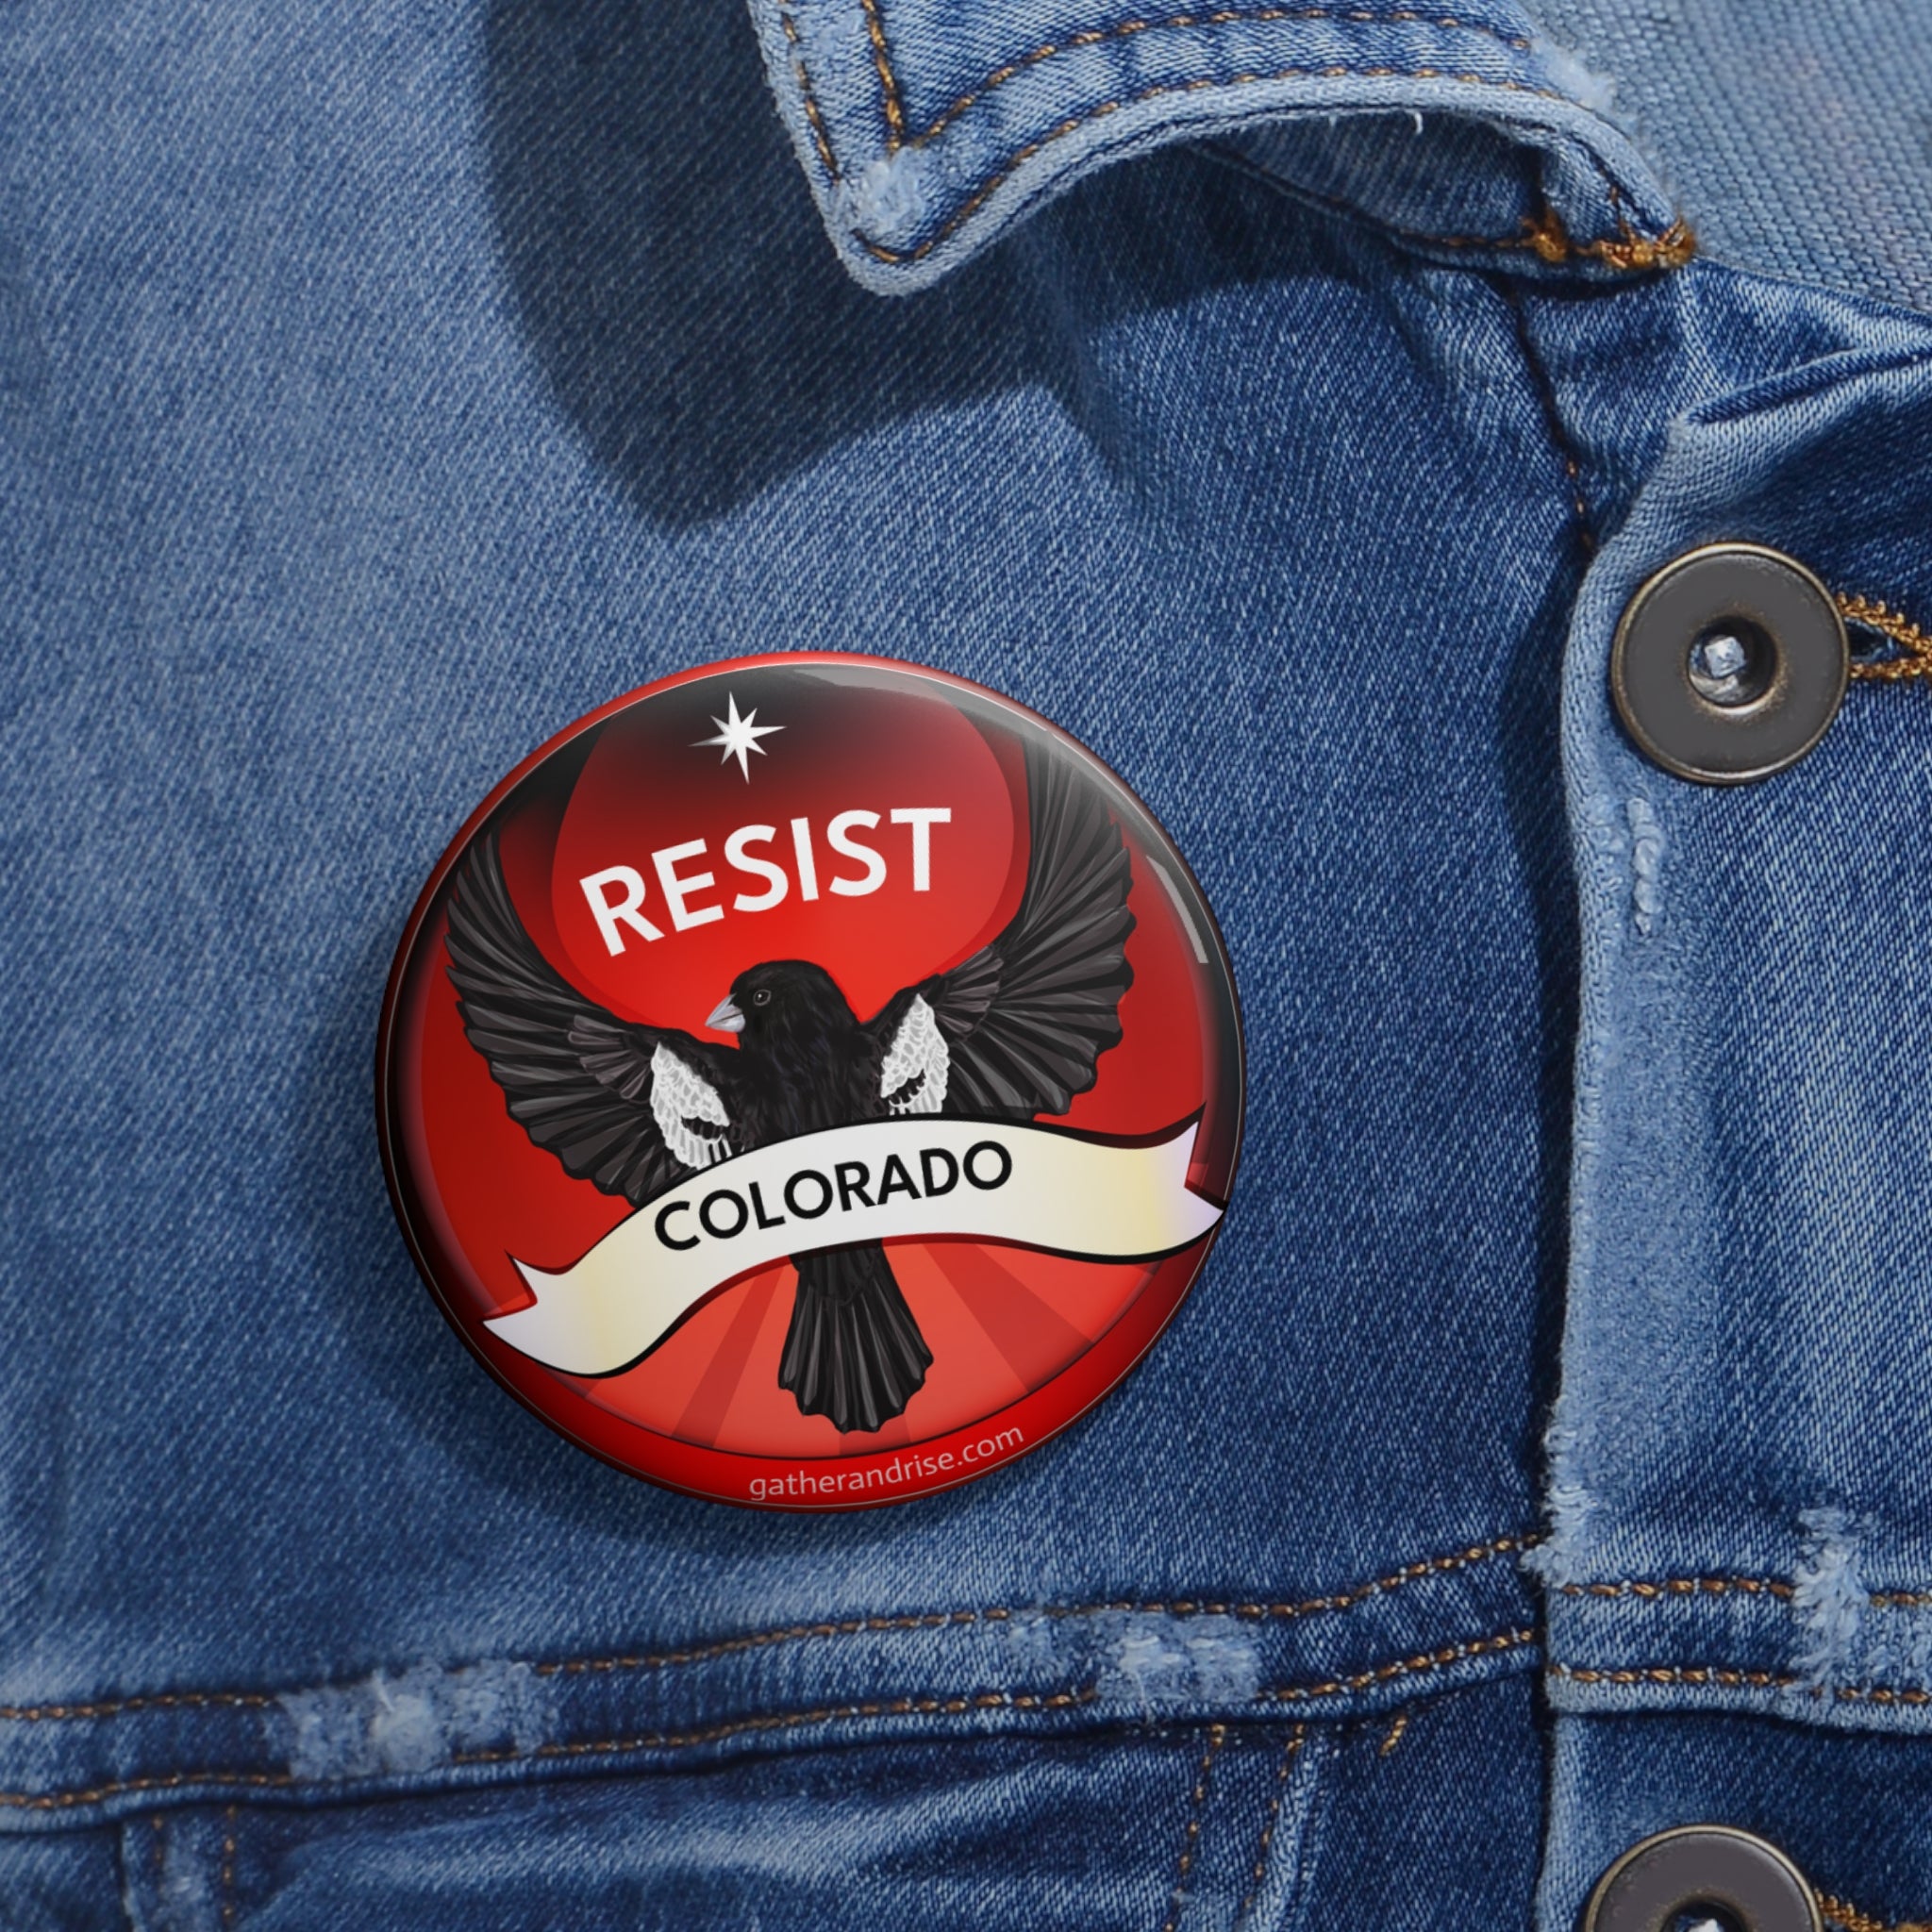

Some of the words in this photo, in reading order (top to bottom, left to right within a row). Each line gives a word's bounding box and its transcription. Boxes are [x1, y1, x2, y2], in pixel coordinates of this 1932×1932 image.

[579, 808, 952, 957] RESIST
[654, 1140, 1012, 1251] COLORADO
[748, 1425, 1025, 1502] gatherandrise.com
